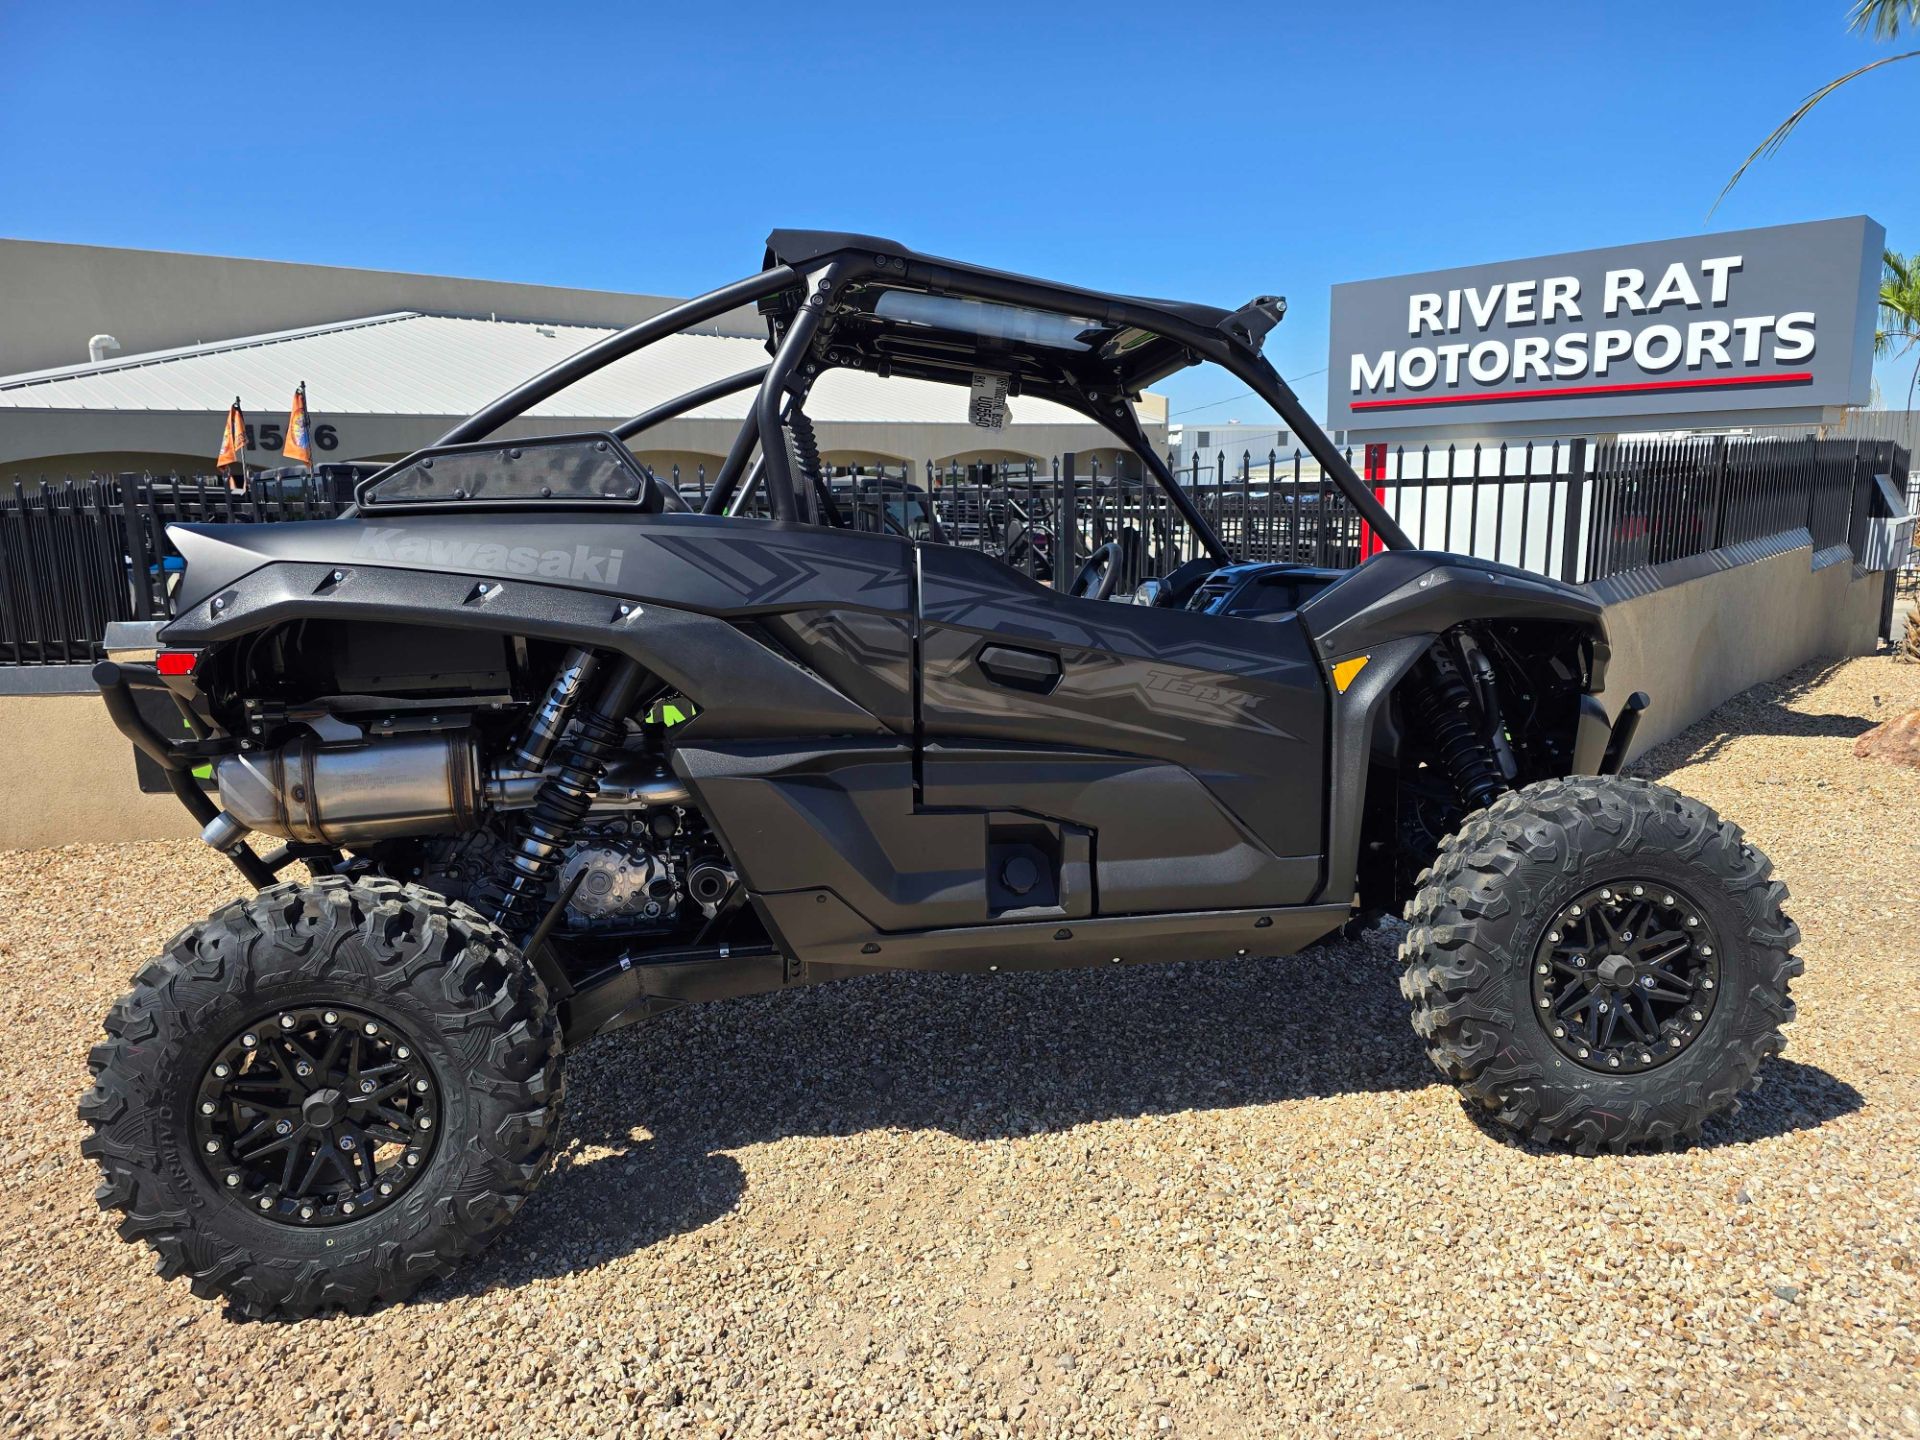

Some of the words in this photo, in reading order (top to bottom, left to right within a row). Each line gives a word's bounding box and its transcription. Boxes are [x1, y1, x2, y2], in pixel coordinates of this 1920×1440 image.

[1408, 276, 1583, 333] RIVER
[1603, 255, 1743, 314] RAT
[1350, 311, 1816, 391] MOTORSPORTS
[244, 424, 339, 451] 156
[975, 397, 993, 428] U05540
[352, 527, 625, 585] Kawasaki
[539, 664, 584, 724] FOX
[1144, 669, 1268, 709] TERYX
